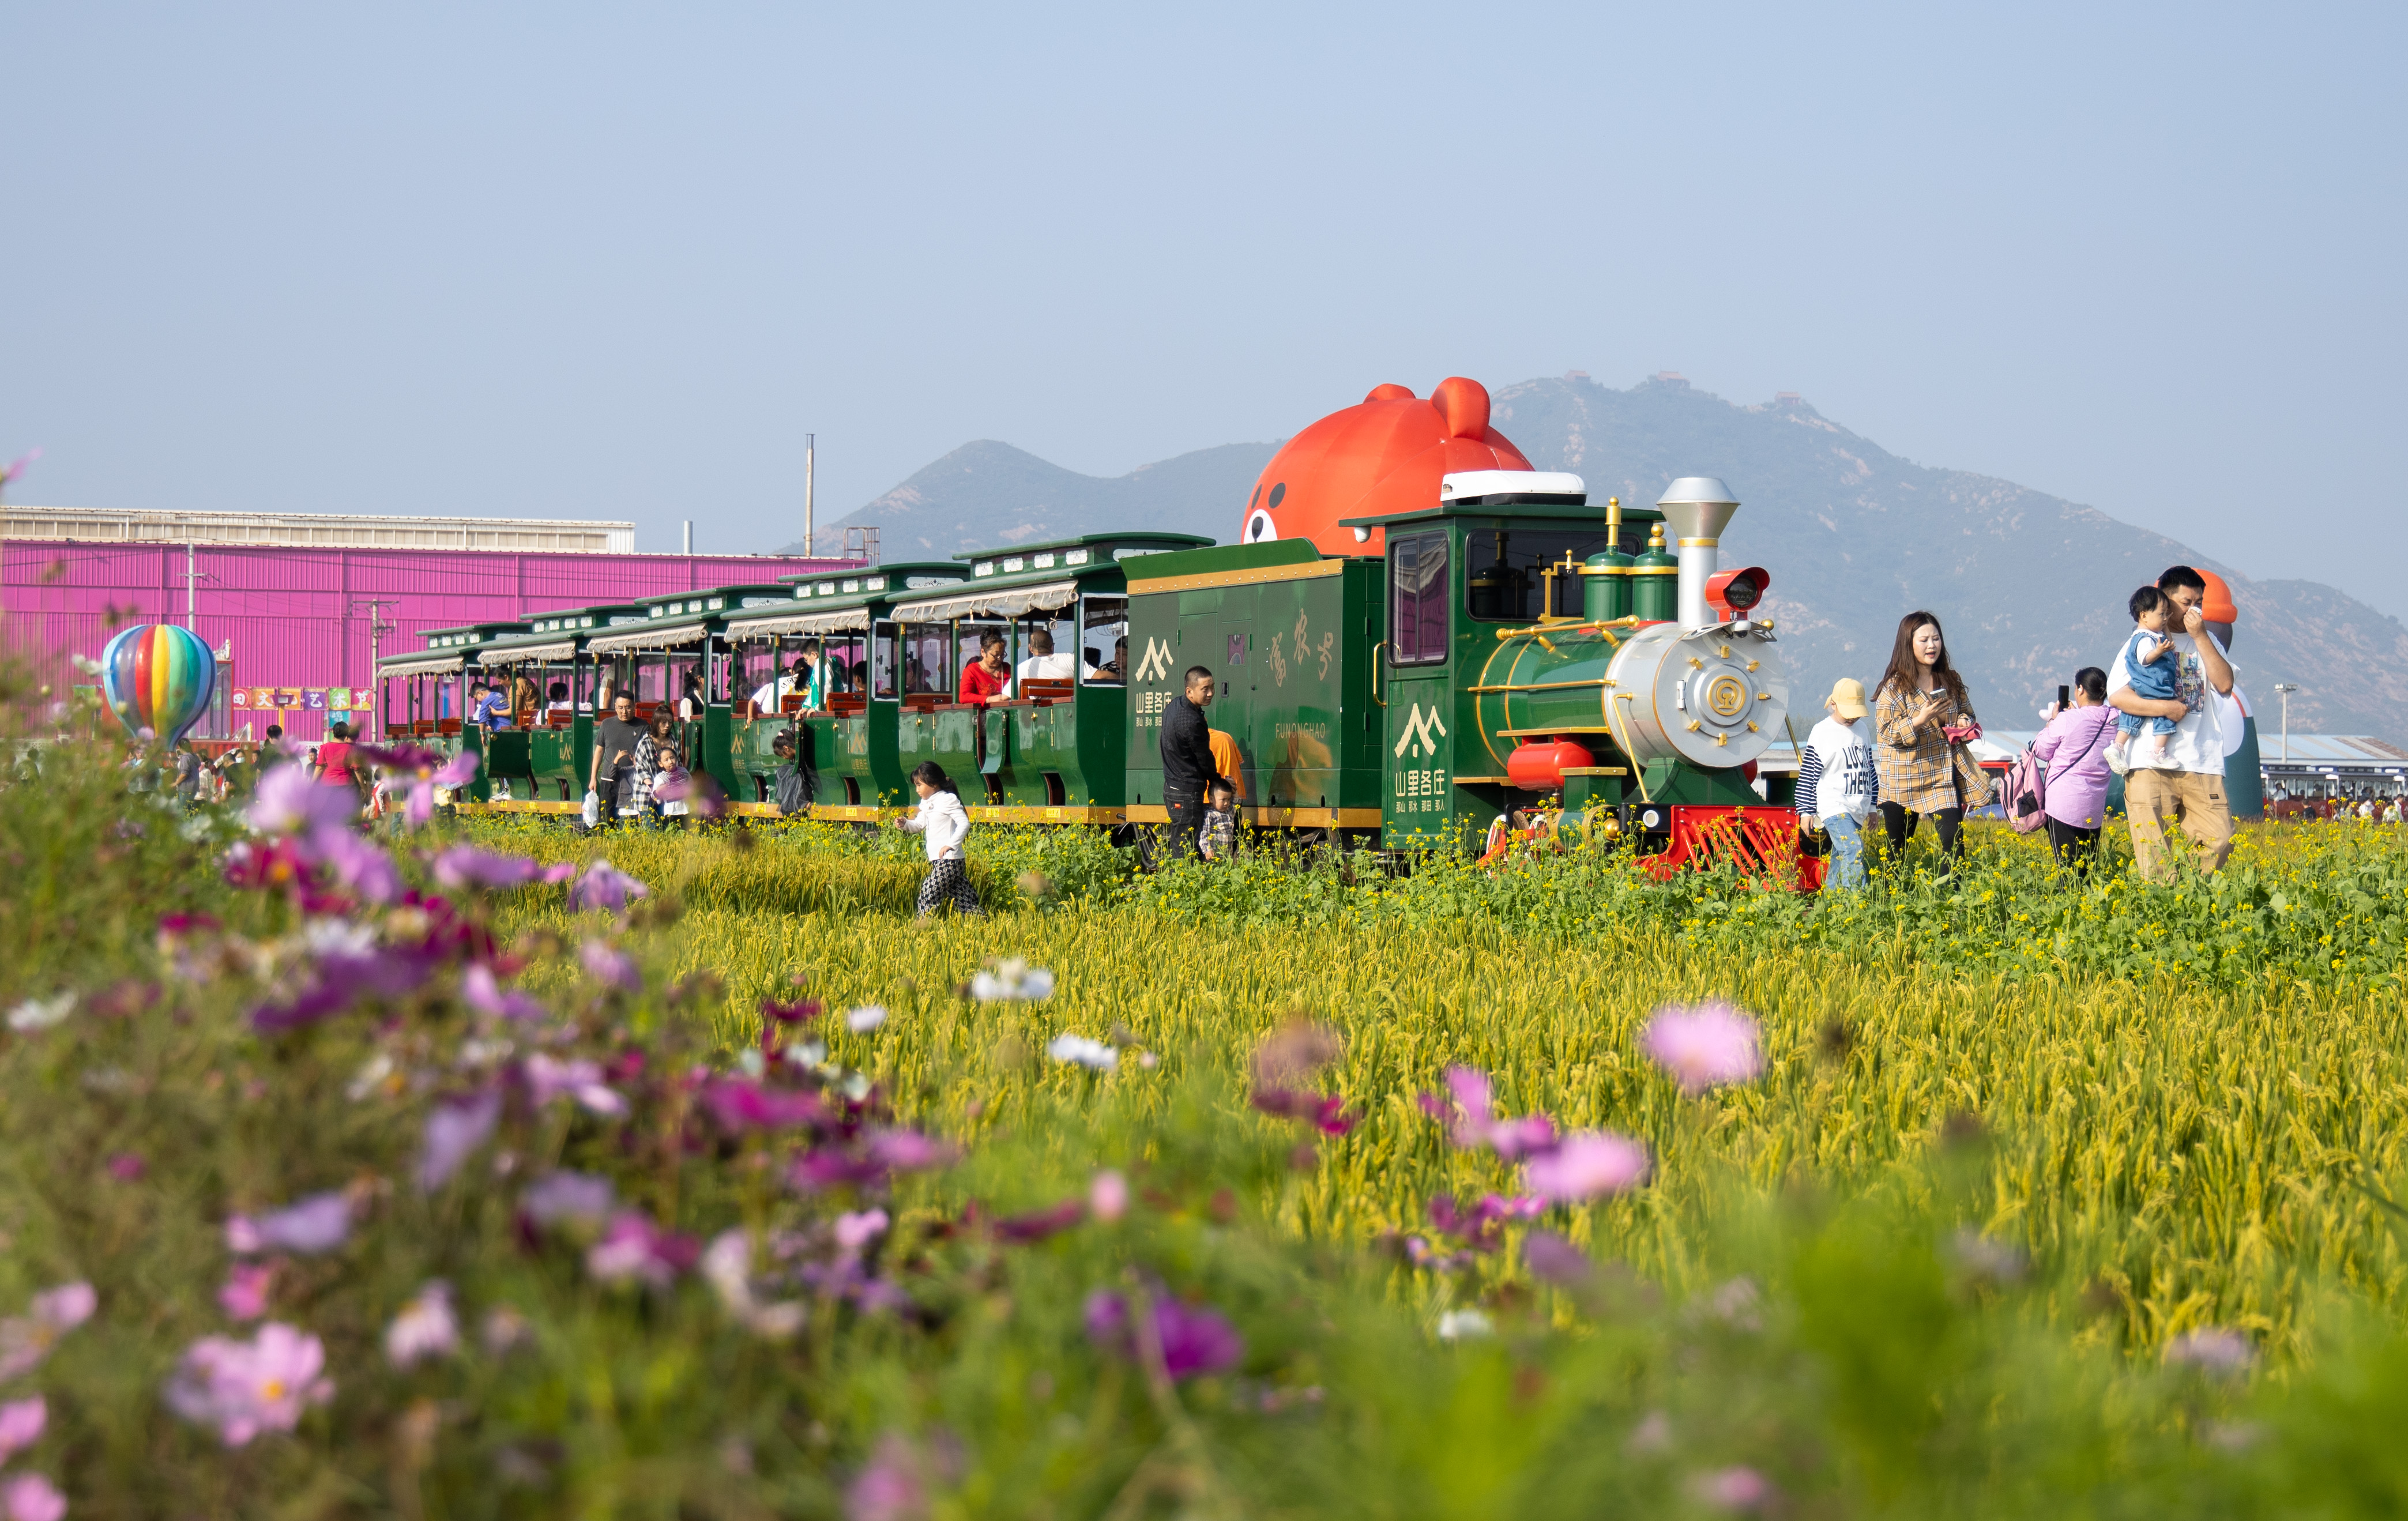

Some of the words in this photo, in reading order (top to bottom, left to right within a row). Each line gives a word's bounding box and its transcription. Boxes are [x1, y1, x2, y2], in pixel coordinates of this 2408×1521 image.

[1136, 691, 1172, 714] 山里各庄
[1276, 722, 1326, 739] FUNONGHAO
[1395, 768, 1445, 797] 山里各庄
[1395, 801, 1406, 813] 那山
[1408, 800, 1418, 812] 那水
[1421, 800, 1432, 812] 那田
[1435, 799, 1445, 812] 那人
